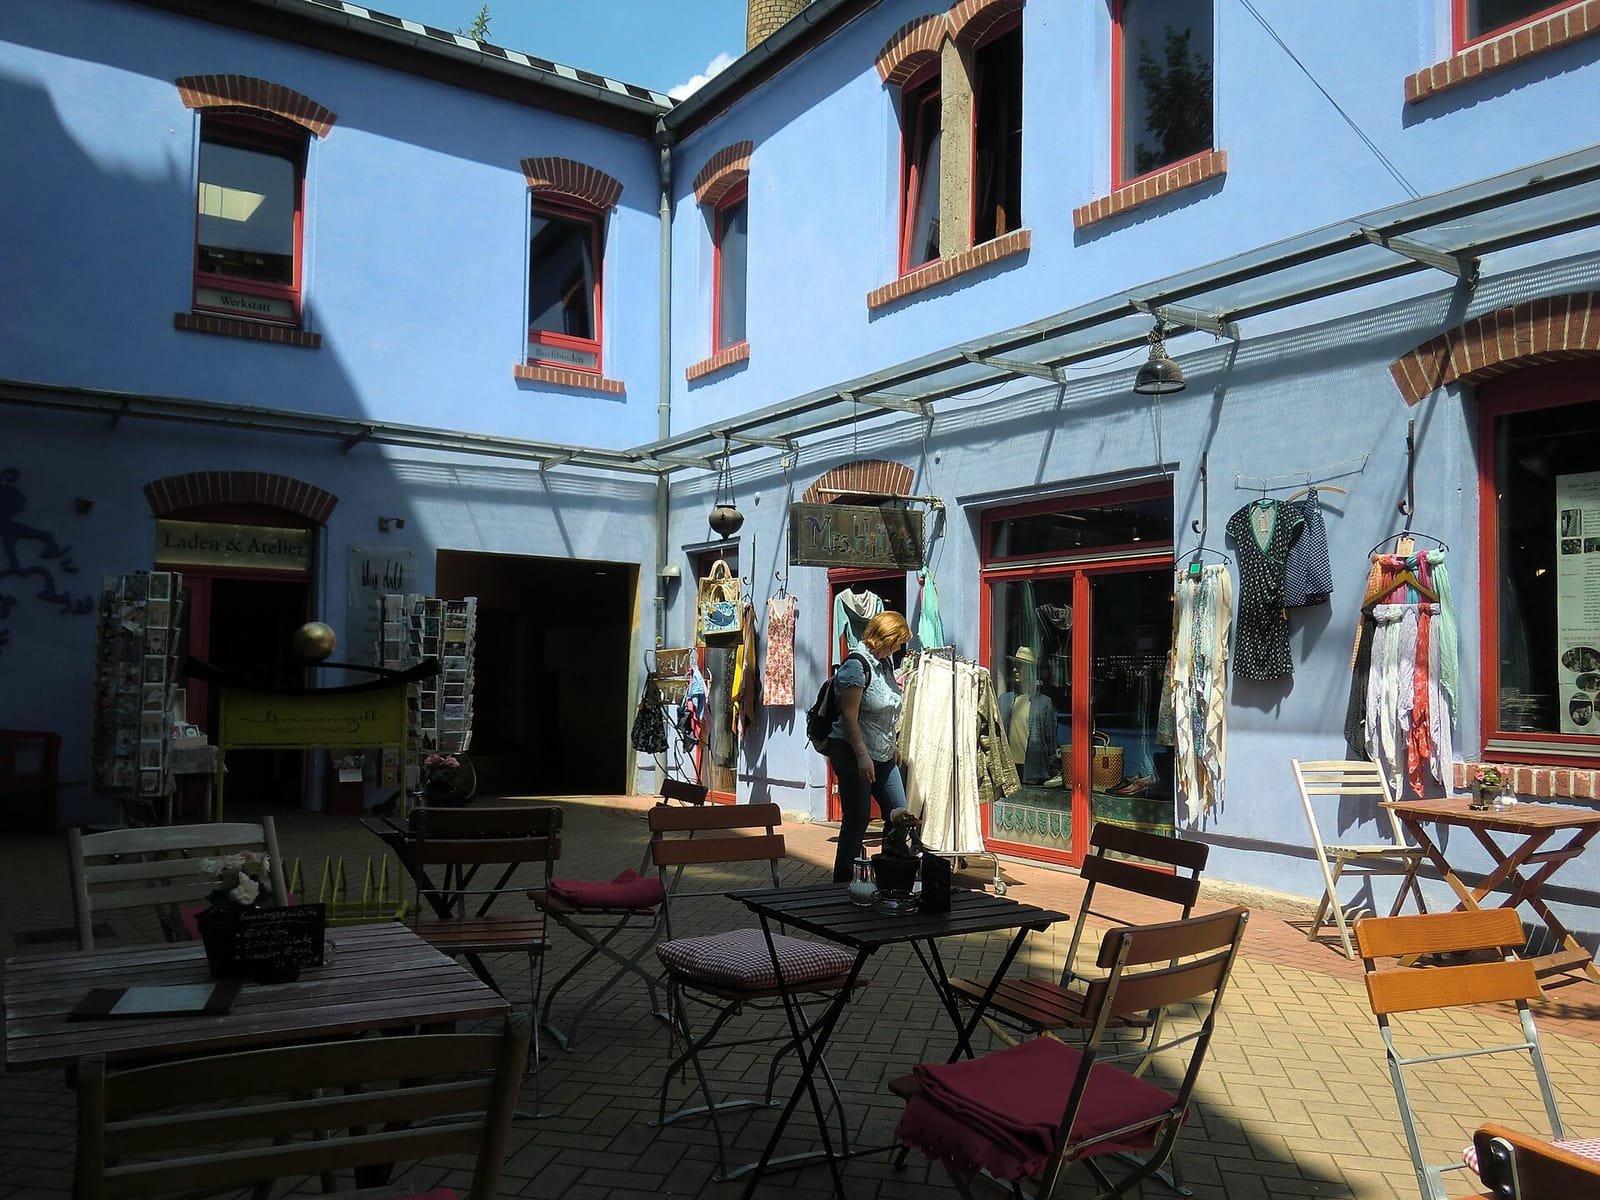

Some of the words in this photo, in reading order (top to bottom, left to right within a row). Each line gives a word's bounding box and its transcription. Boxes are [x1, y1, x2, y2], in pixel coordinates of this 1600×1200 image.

[220, 294, 272, 313] Werkstatt
[535, 346, 585, 364] Buchbinden
[164, 532, 219, 551] Laden
[226, 540, 241, 552] &
[248, 537, 306, 556] Atelier
